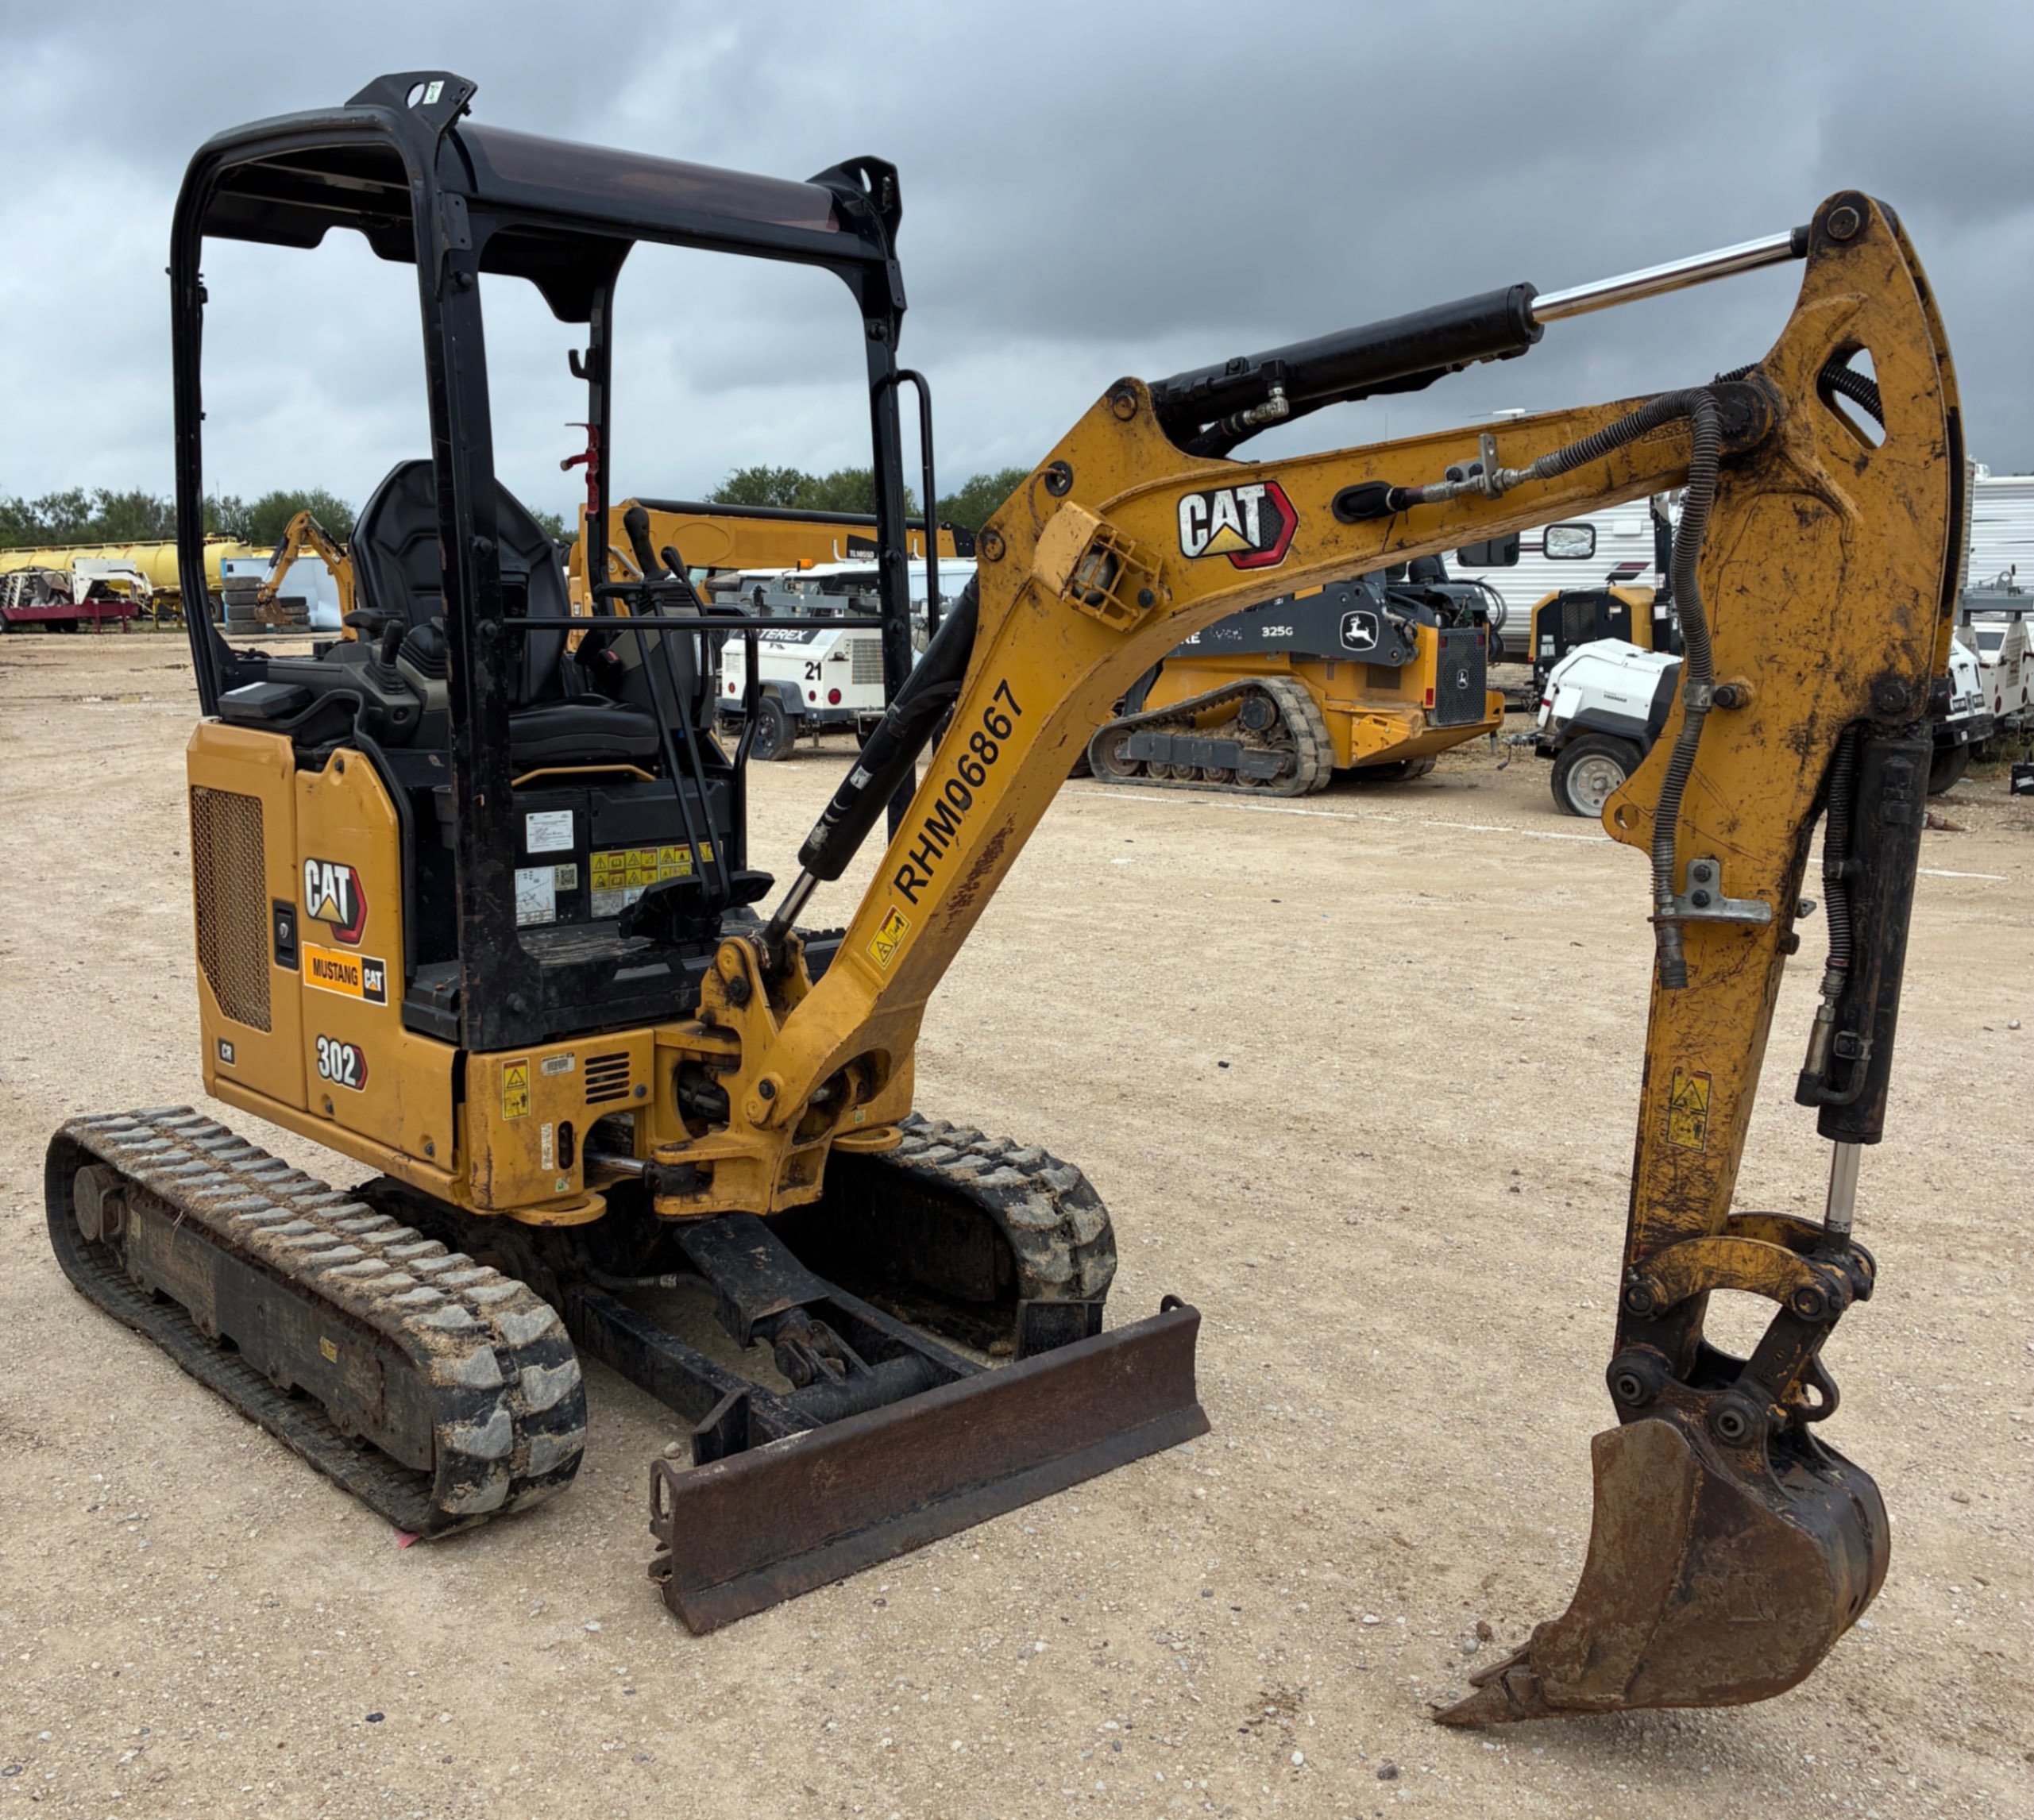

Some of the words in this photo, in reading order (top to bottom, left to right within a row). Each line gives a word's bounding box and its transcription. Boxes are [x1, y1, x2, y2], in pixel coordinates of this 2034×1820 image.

[1179, 483, 1266, 557] CAT
[759, 628, 809, 642] TEREX
[1261, 626, 1294, 638] 325G
[805, 661, 821, 681] 21
[893, 678, 1023, 906] RHM06867
[304, 858, 350, 925] CAT
[312, 958, 358, 986] MUSTANG
[364, 969, 383, 992] CAT
[222, 1043, 232, 1061] CR
[318, 1035, 357, 1086] 302
